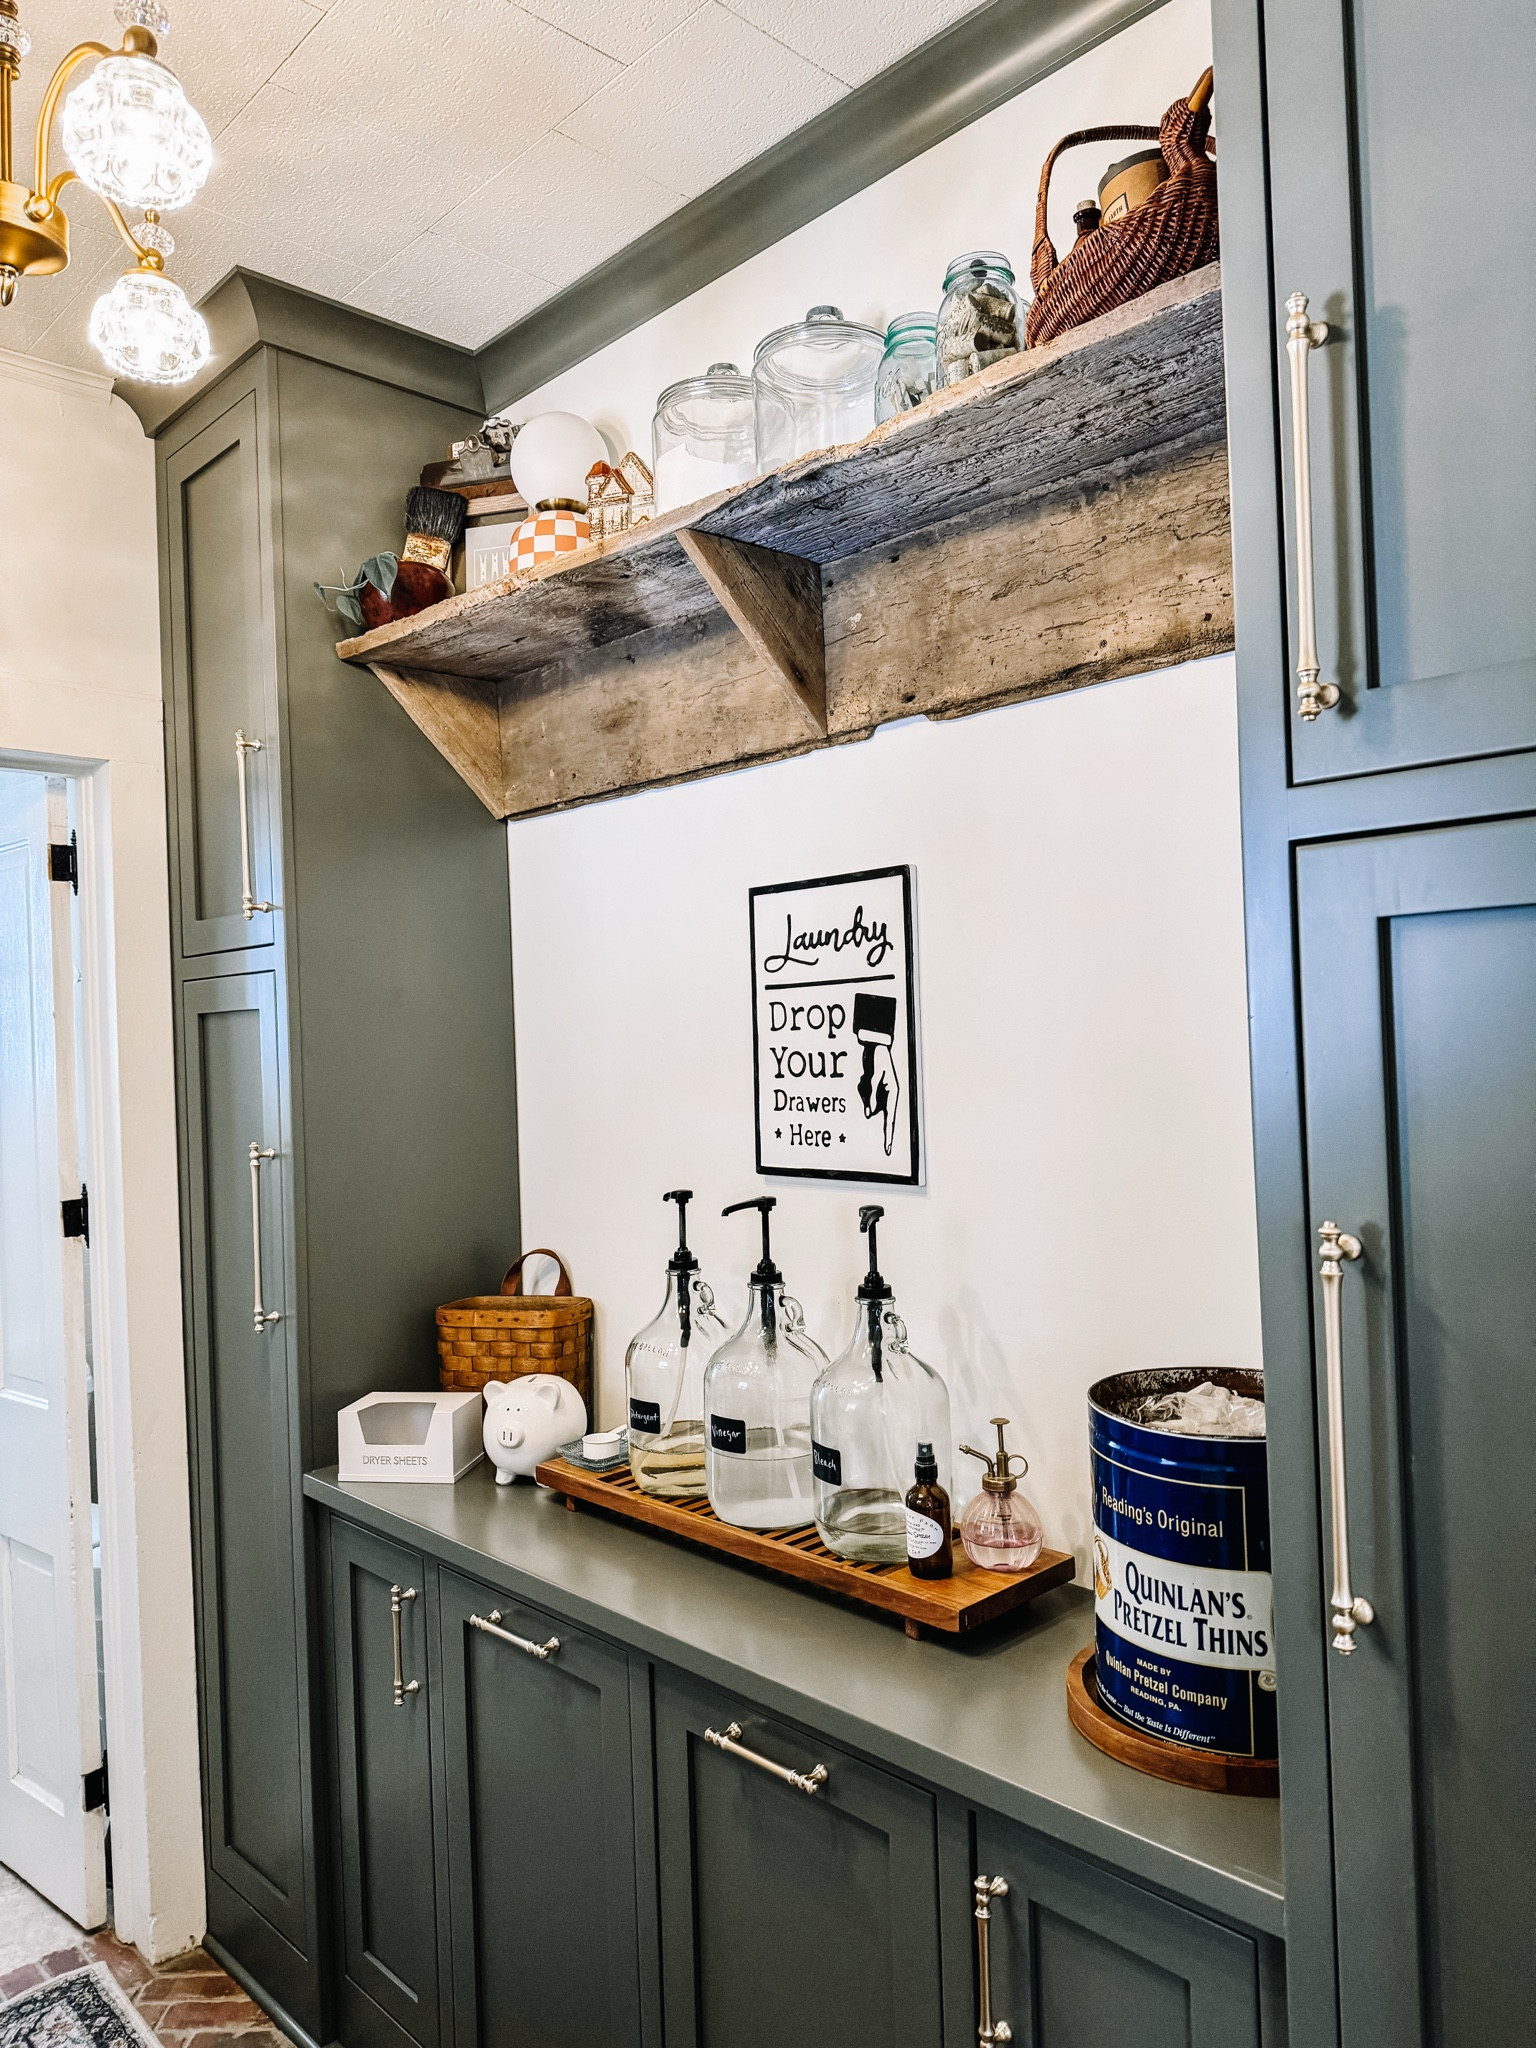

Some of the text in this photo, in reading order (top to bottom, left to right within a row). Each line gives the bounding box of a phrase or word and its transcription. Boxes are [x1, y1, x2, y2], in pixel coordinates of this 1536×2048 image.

[764, 905, 894, 973] Laundry
[769, 1001, 846, 1039] Drop
[769, 1046, 848, 1079] Your
[773, 1089, 846, 1114] Drawers
[789, 1123, 832, 1147] Here
[630, 1408, 659, 1424] Detergent
[711, 1425, 741, 1442] Vinegar
[363, 1455, 428, 1466] DRYER SHEETS
[813, 1449, 837, 1472] Bleach
[1102, 1485, 1224, 1538] Reading's Original
[1114, 1588, 1268, 1657] PRETZEL THINS
[1136, 1657, 1171, 1677] MADE BY
[1105, 1650, 1131, 1679] Quinlan
[1133, 1668, 1168, 1695] Pretzel
[1172, 1684, 1228, 1710] Company
[1123, 1704, 1134, 1717] But
[1134, 1711, 1145, 1722] the
[1146, 1716, 1164, 1730] Taste
[1164, 1724, 1171, 1733] Is
[1168, 1701, 1182, 1712] PA.
